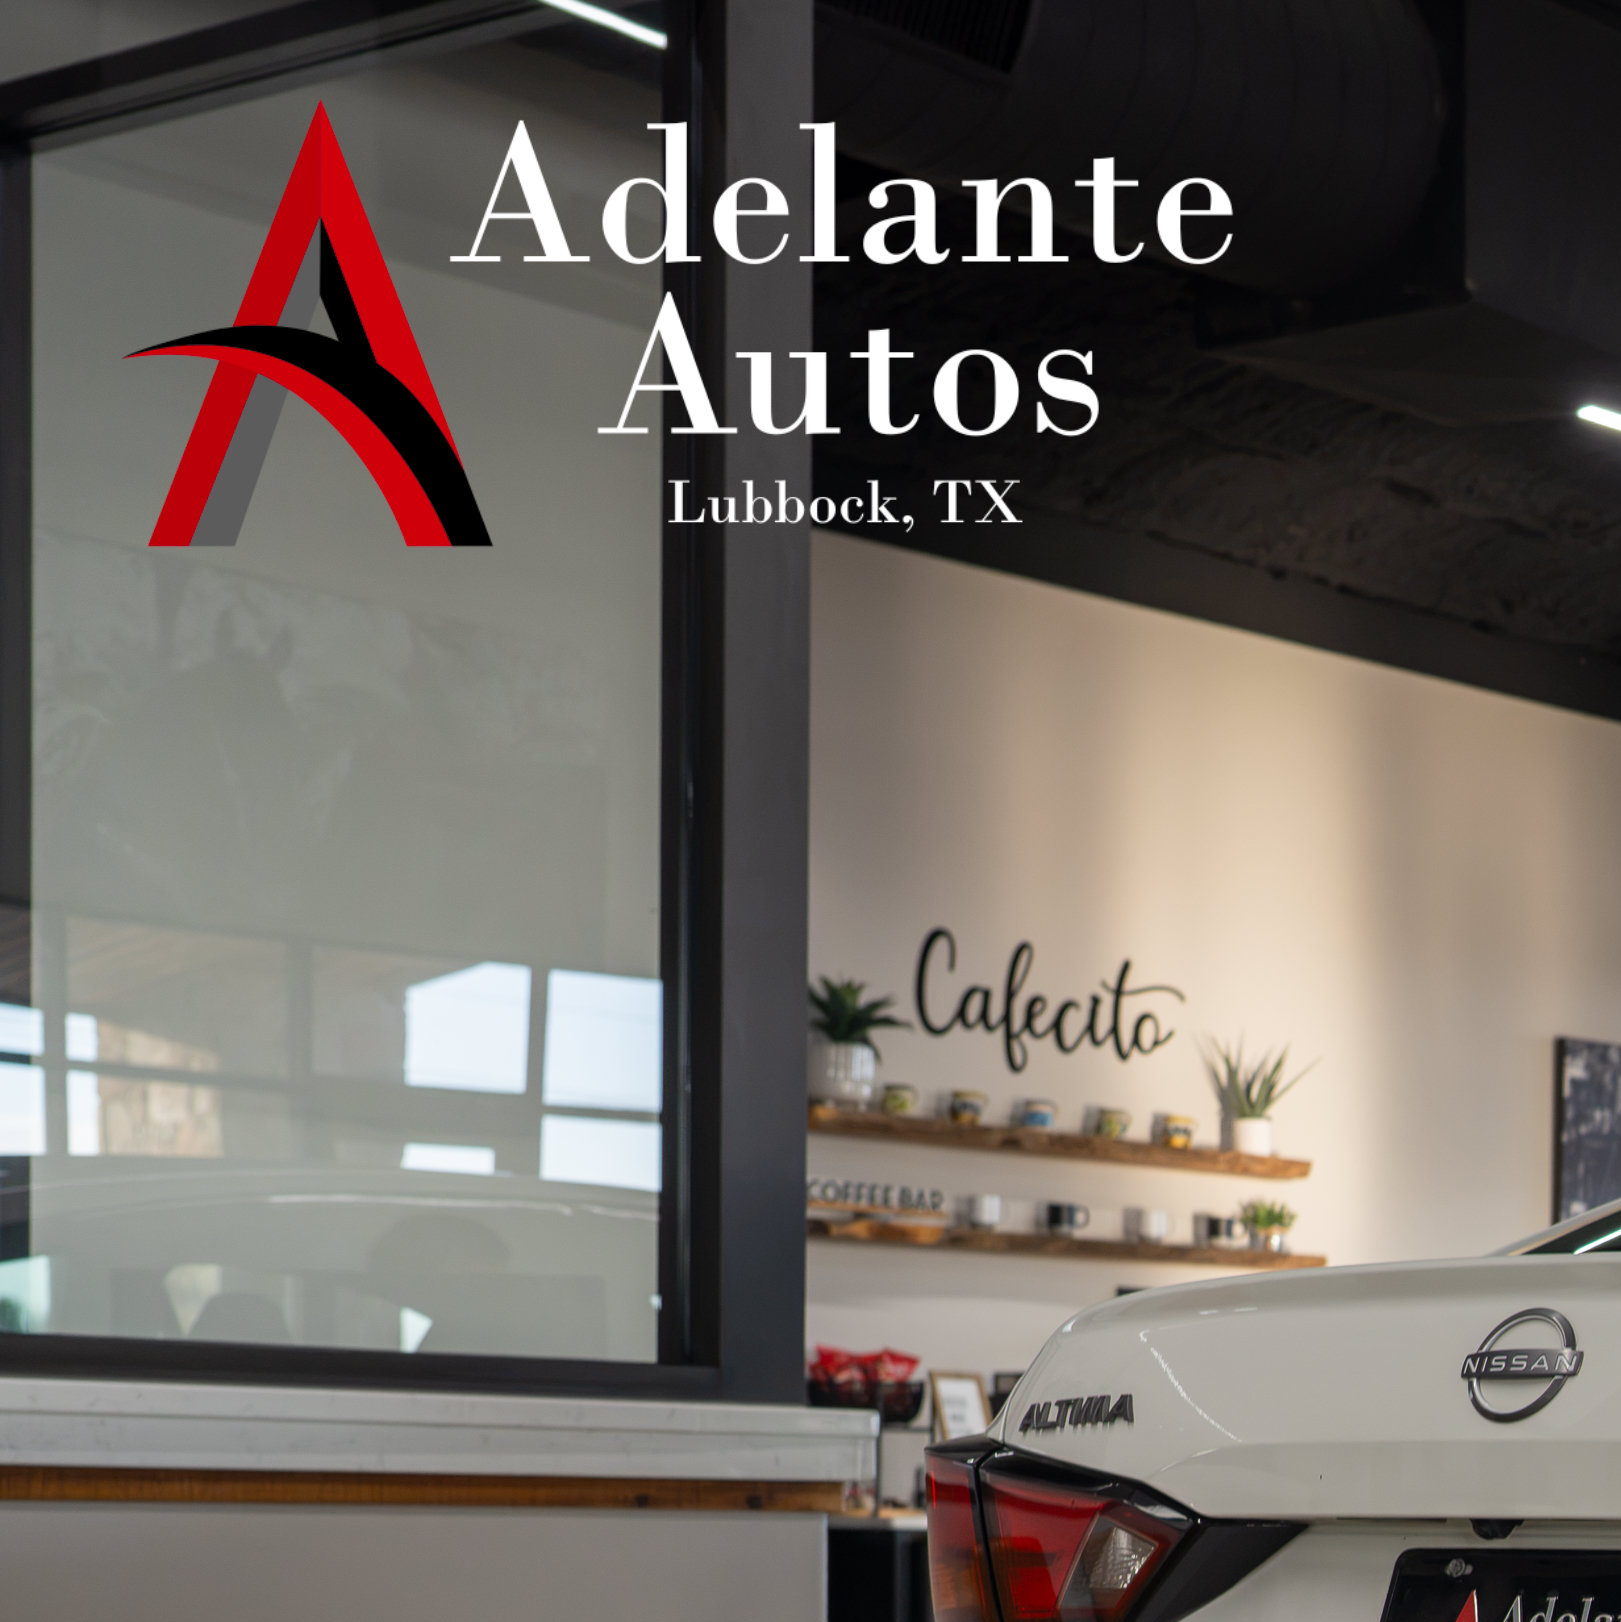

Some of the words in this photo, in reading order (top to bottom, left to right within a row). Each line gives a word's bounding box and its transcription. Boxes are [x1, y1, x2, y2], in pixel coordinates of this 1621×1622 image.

[916, 926, 1187, 1074] Cafecito
[807, 1177, 895, 1207] COFFEE
[898, 1184, 945, 1210] BAR
[1463, 1354, 1577, 1375] NISSAN
